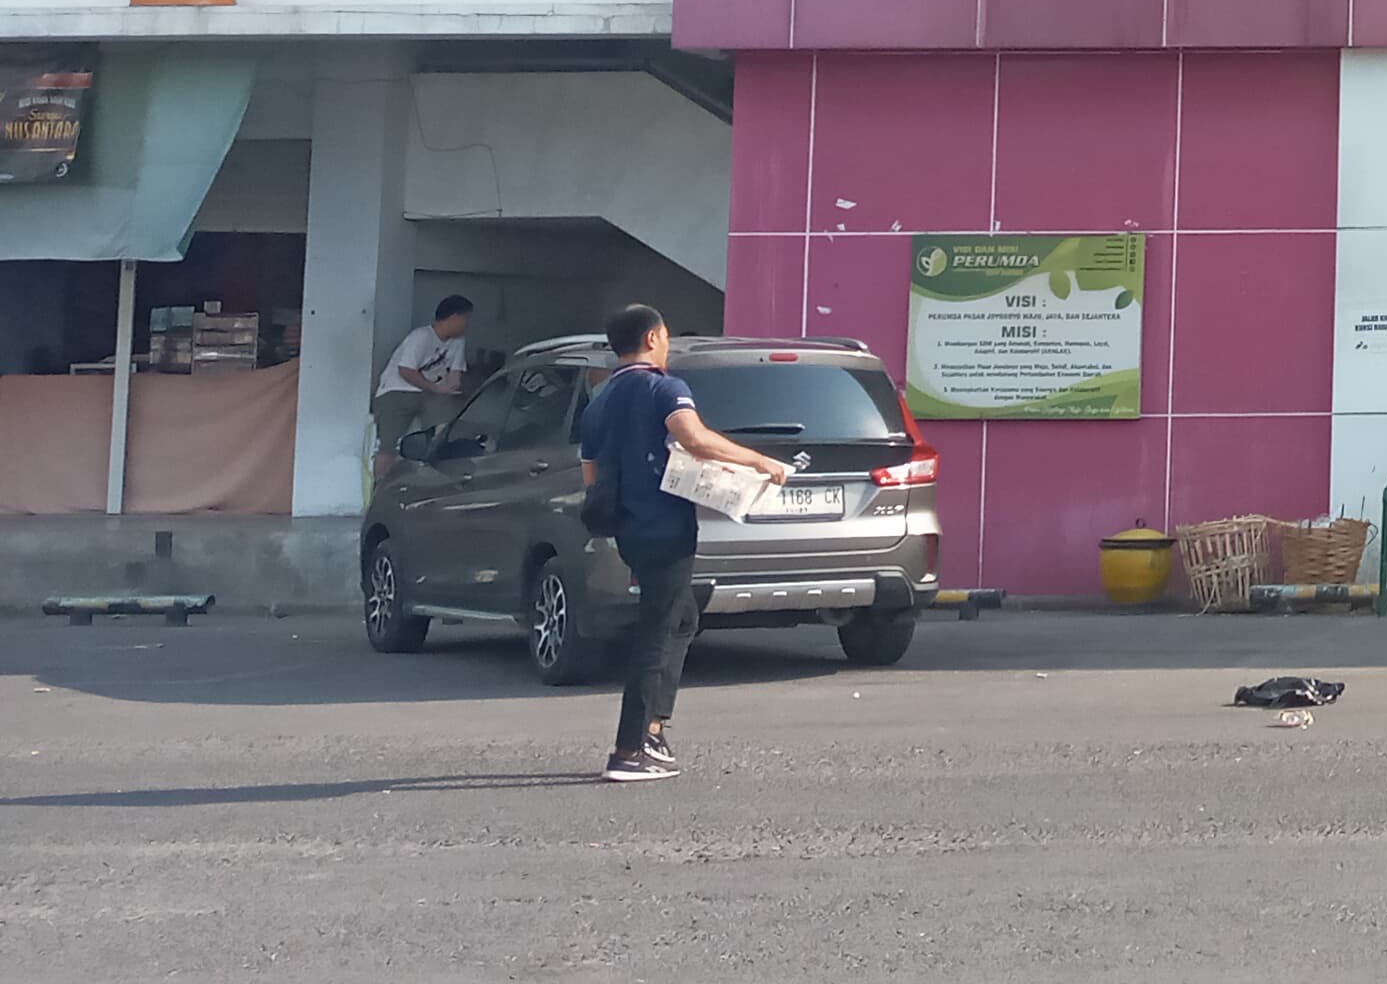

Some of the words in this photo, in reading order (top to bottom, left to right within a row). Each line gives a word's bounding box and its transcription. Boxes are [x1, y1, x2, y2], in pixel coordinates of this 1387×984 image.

[952, 255, 1040, 267] PERUMDA
[1005, 295, 1037, 308] VISI
[1001, 325, 1037, 338] MISI
[780, 488, 813, 505] 1168
[824, 488, 841, 504] CK
